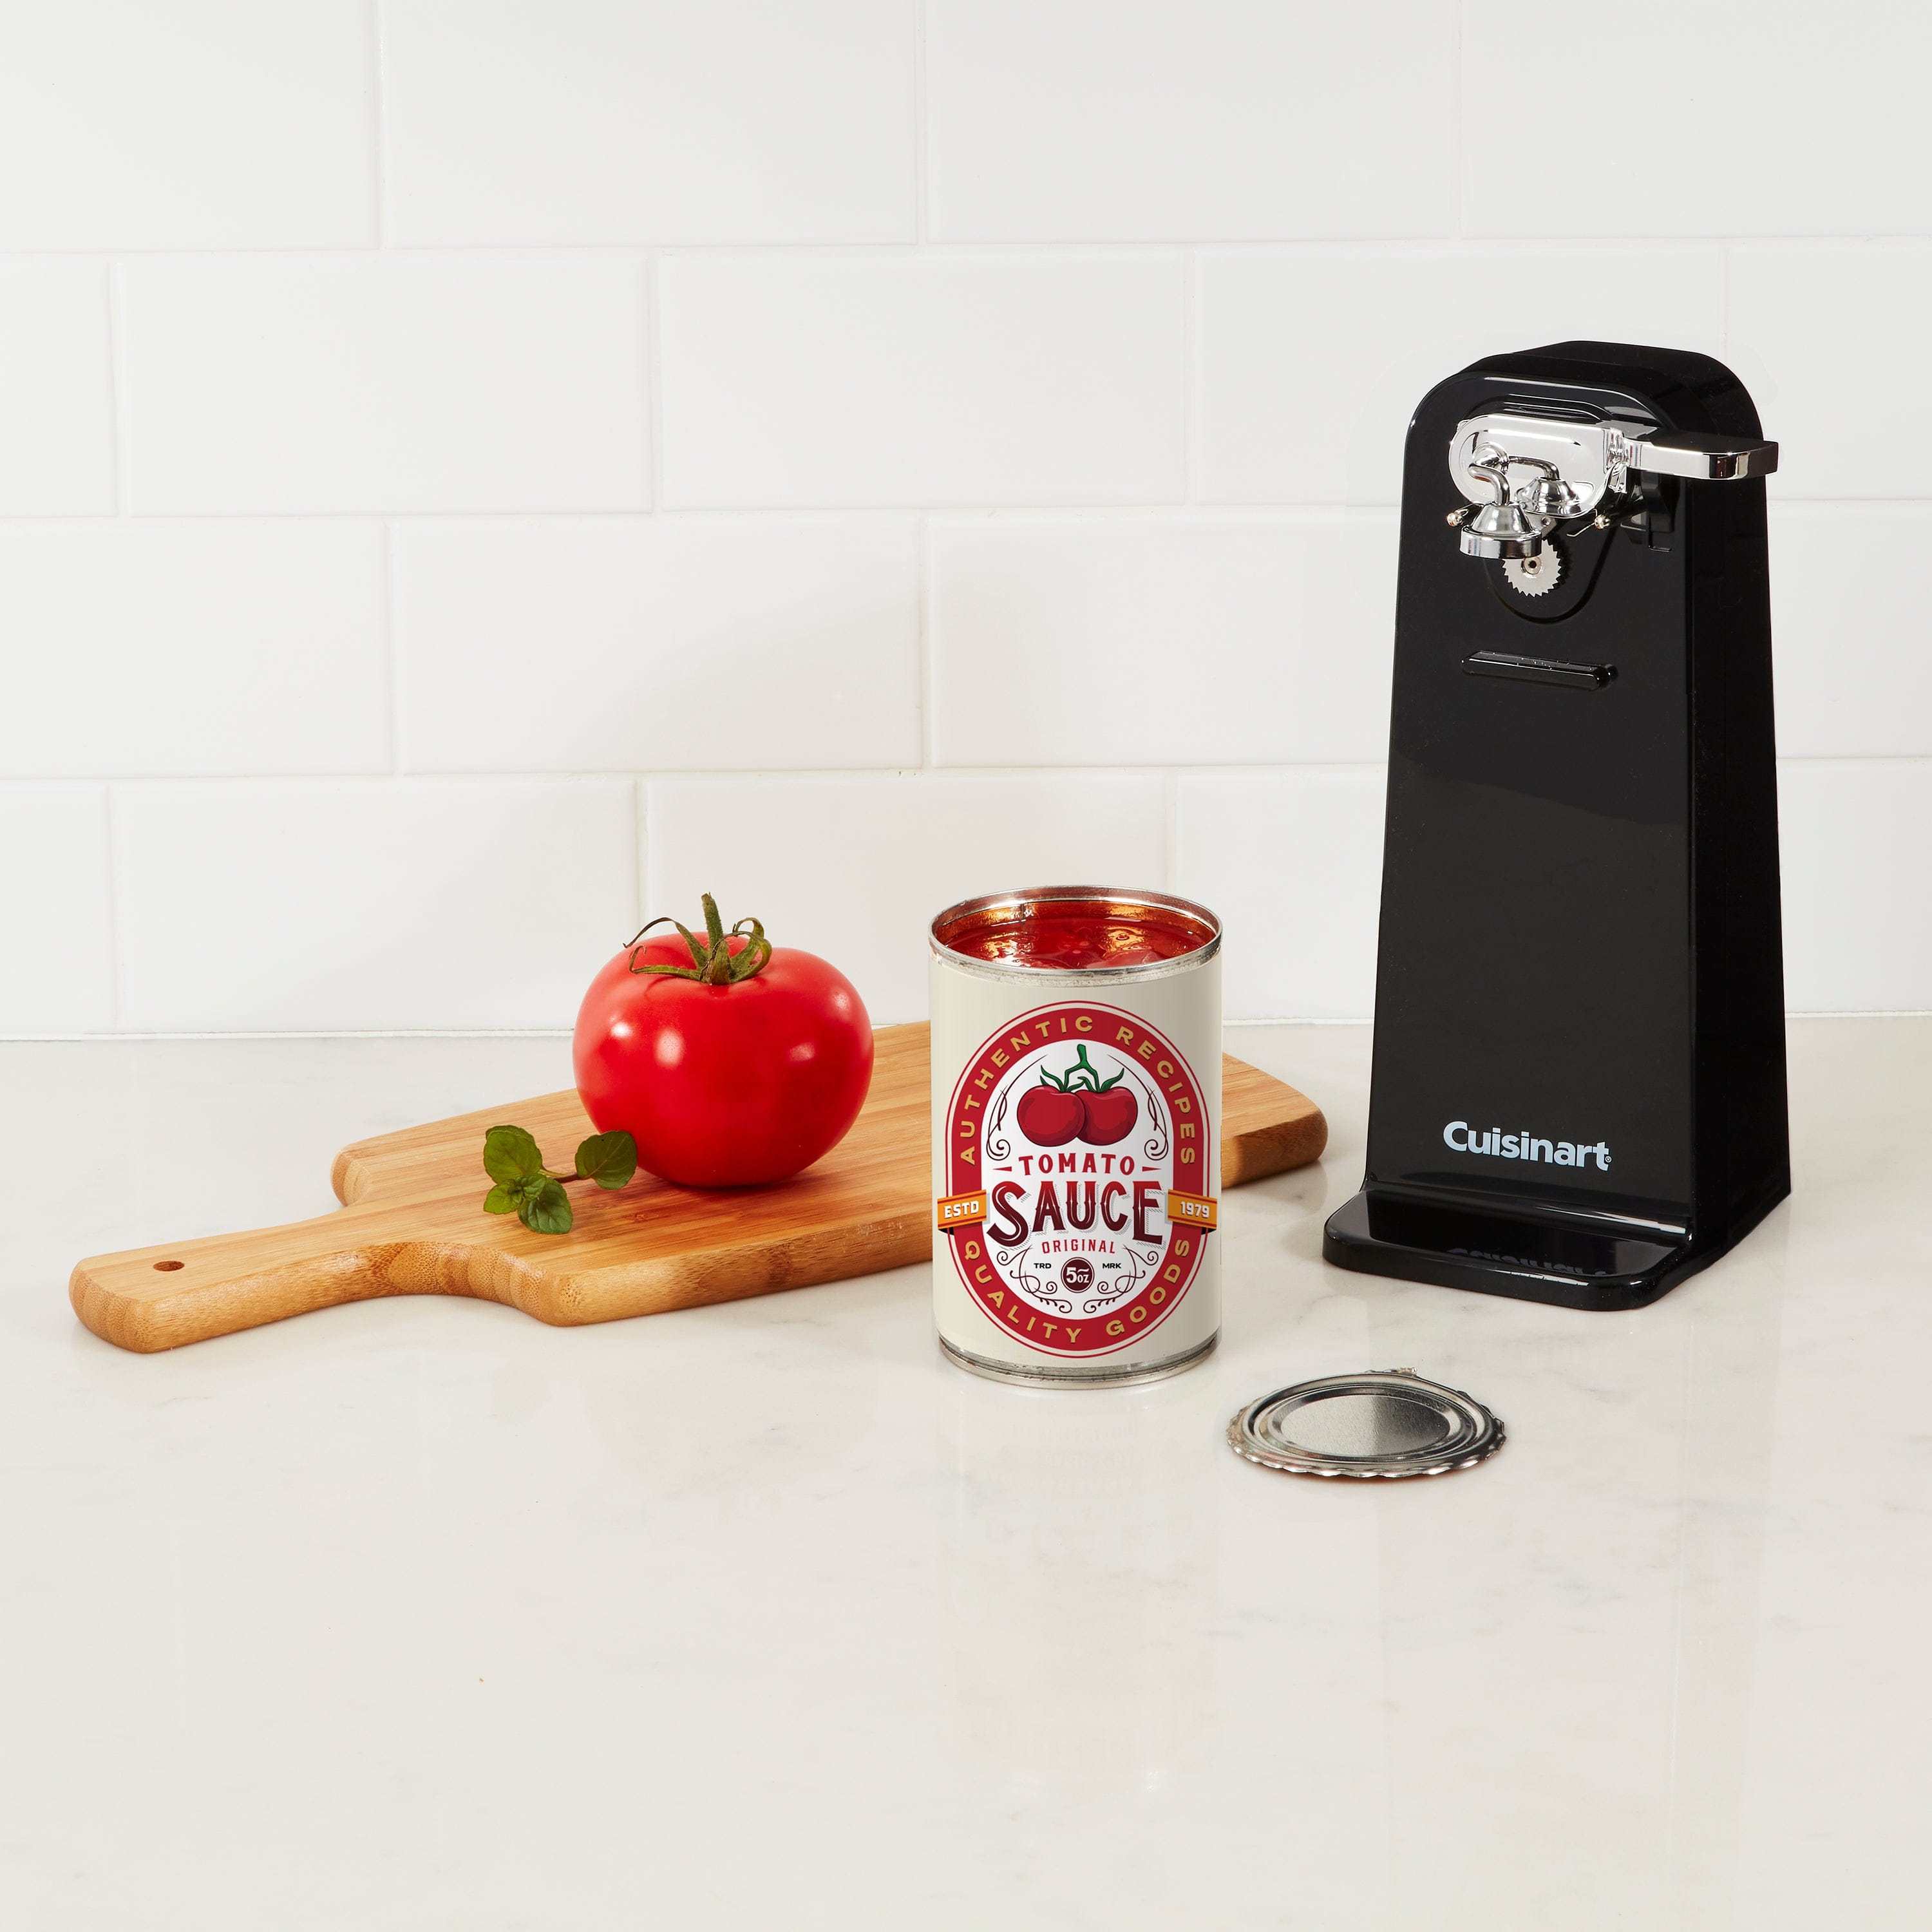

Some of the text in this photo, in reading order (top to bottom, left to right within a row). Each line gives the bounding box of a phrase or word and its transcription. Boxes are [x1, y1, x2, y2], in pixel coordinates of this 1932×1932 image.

[960, 1016, 1196, 1164] AUTHENTIC RECIPES
[1019, 1153, 1135, 1176] TOMATO
[943, 1200, 980, 1218] ESTD
[987, 1181, 1164, 1247] SAUCE
[1180, 1201, 1210, 1218] 1979
[1042, 1239, 1116, 1255] ORIGINAL
[965, 1239, 1190, 1343] QUALITY GOODS
